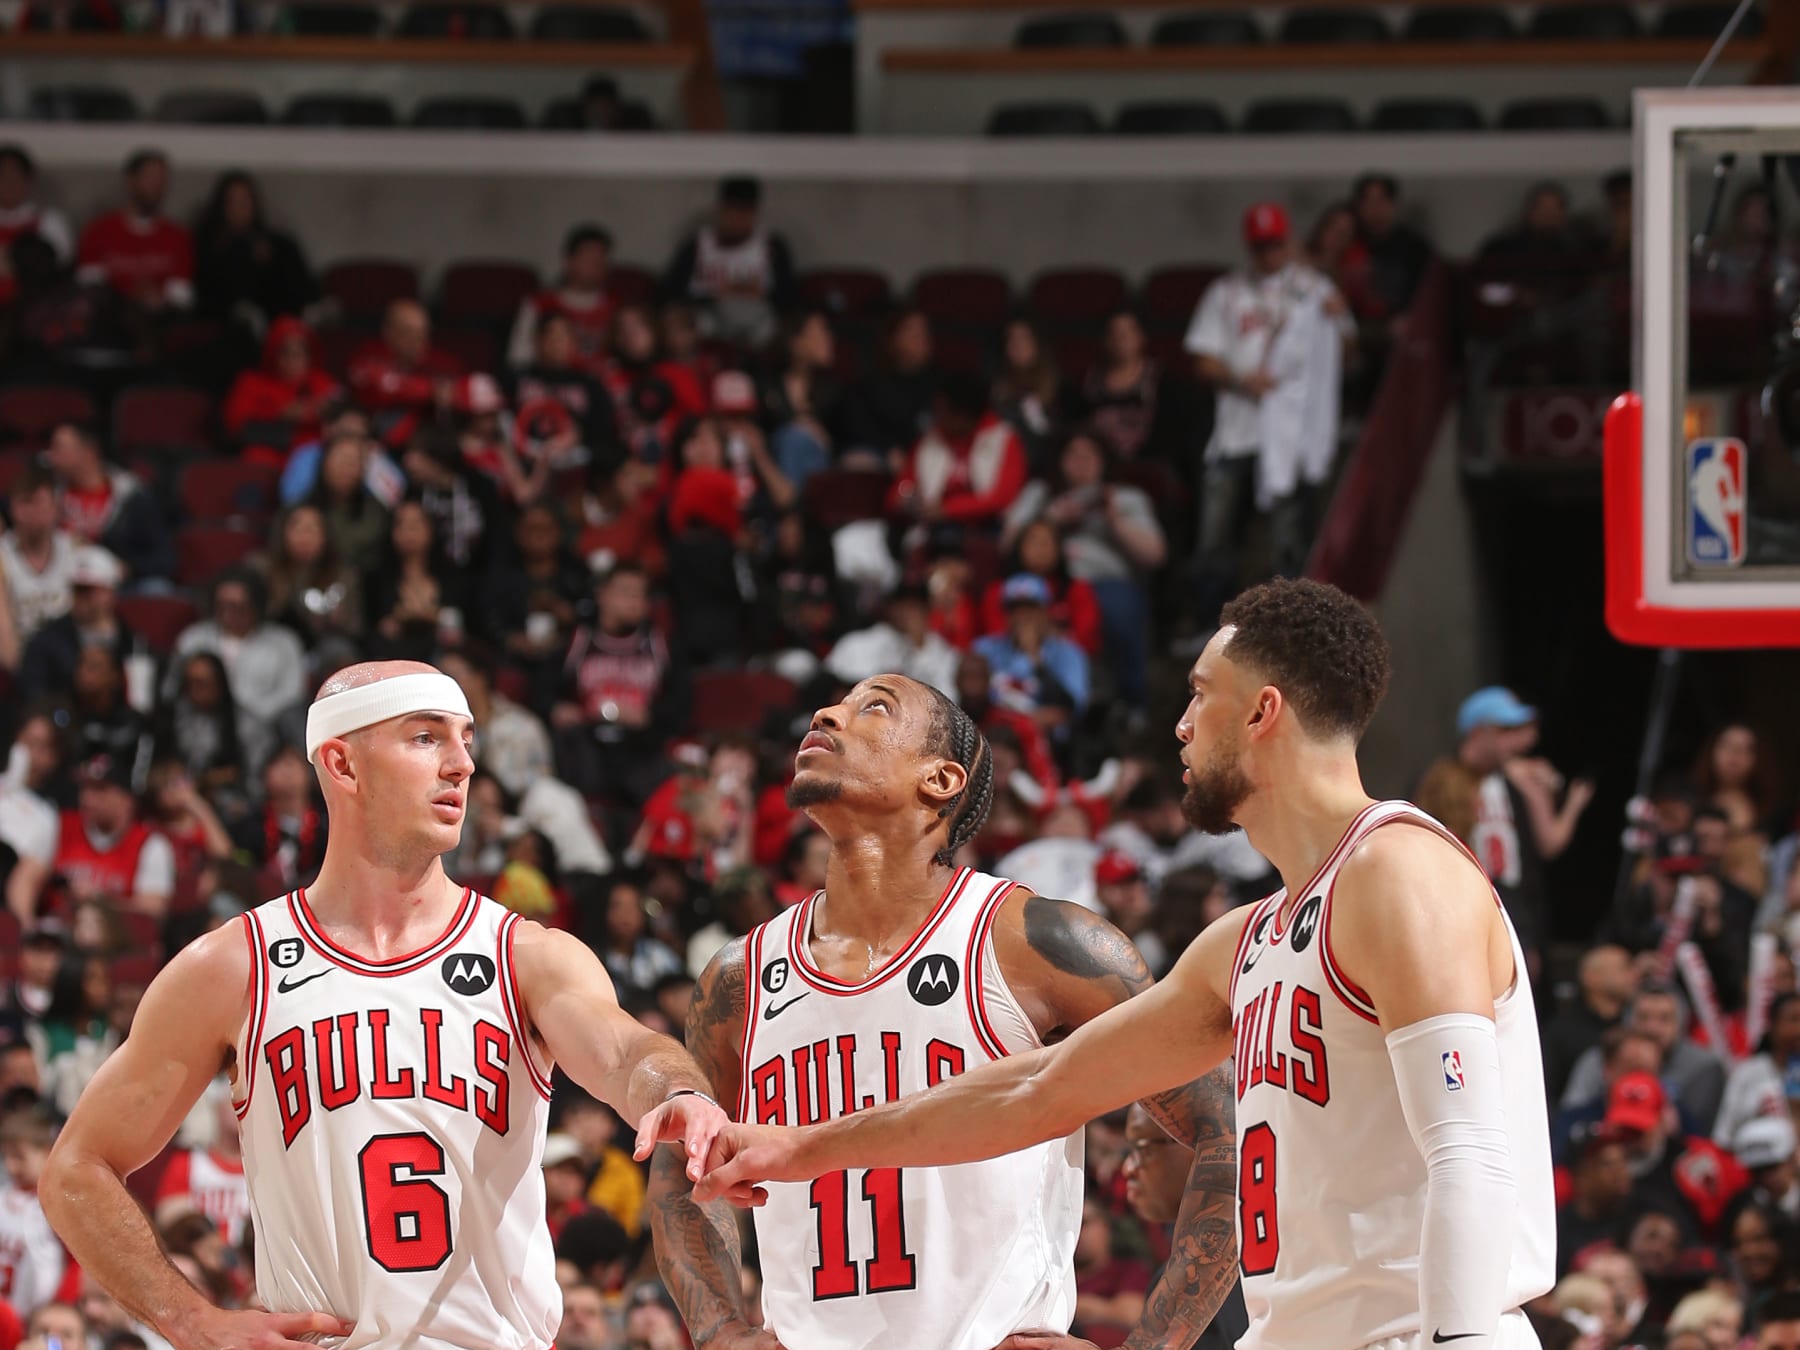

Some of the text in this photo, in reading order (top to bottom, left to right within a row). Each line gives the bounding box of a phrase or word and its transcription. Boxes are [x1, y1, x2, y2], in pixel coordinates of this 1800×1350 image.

[277, 941, 298, 964] 6
[768, 962, 786, 990] 6
[264, 1008, 510, 1150] BULLS
[1233, 981, 1330, 1108] ULLS
[357, 1131, 454, 1273] 6
[809, 1167, 917, 1302] 11
[1239, 1120, 1280, 1278] 8
